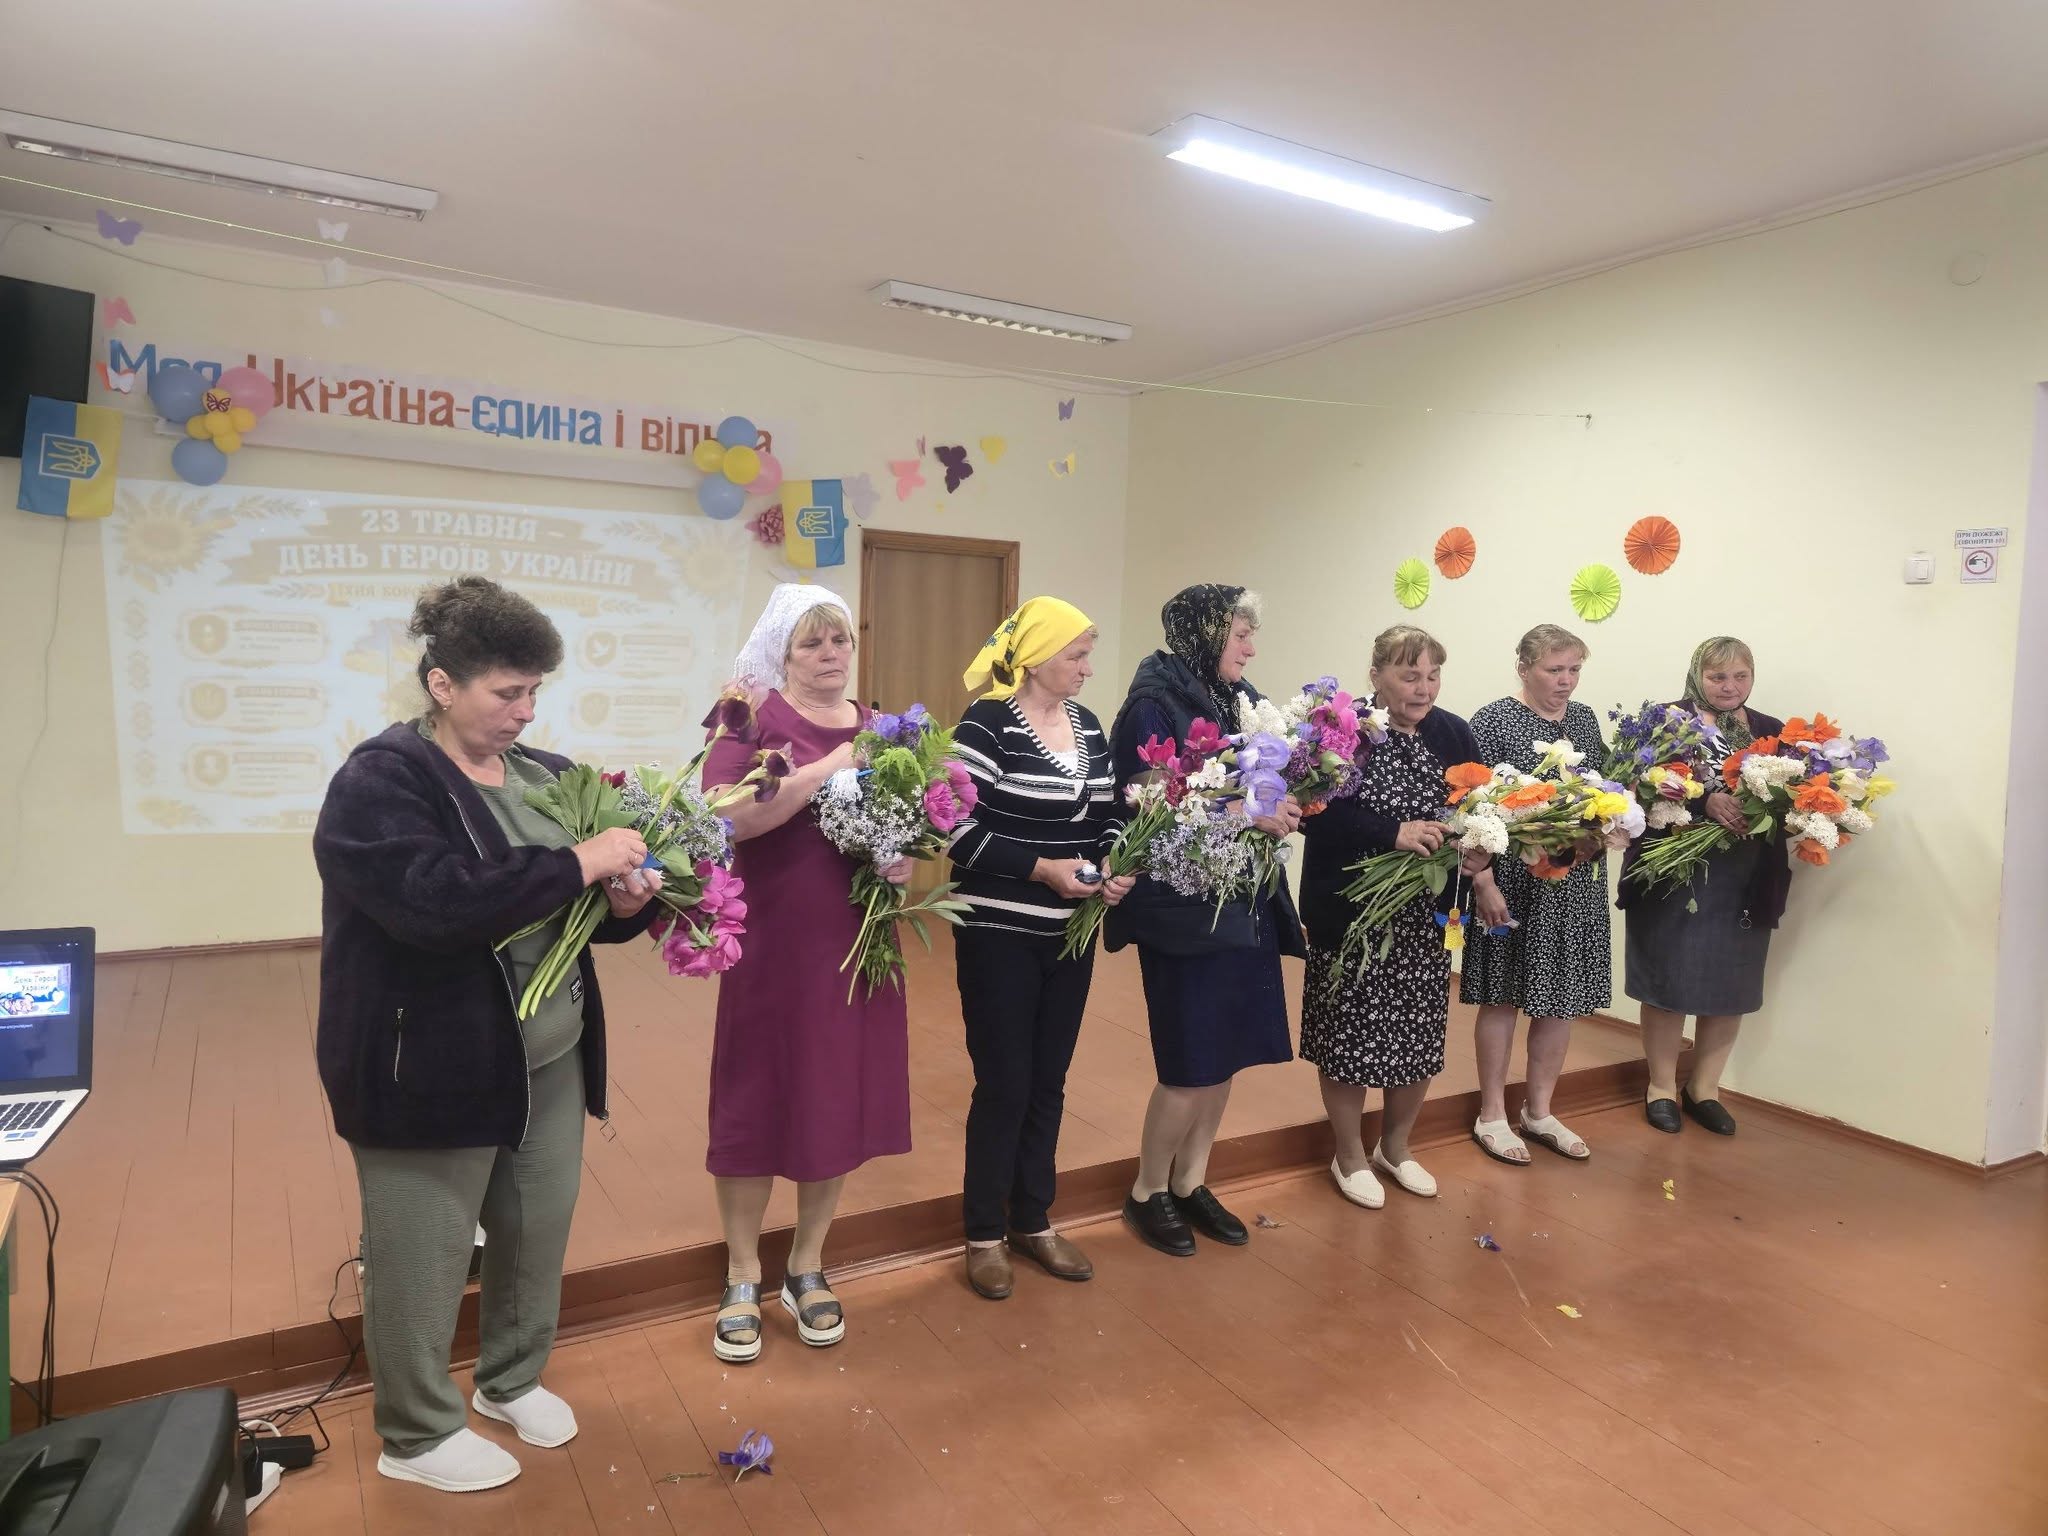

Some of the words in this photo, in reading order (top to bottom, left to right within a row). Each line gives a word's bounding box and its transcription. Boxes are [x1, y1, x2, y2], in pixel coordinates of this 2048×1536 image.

[360, 508, 400, 534] 23
[410, 510, 538, 542] ТРАВНЯ
[278, 543, 369, 575] ДЕНЬ
[379, 542, 490, 573] ГЕРОЇВ
[501, 549, 635, 586] УКРАЇНИ
